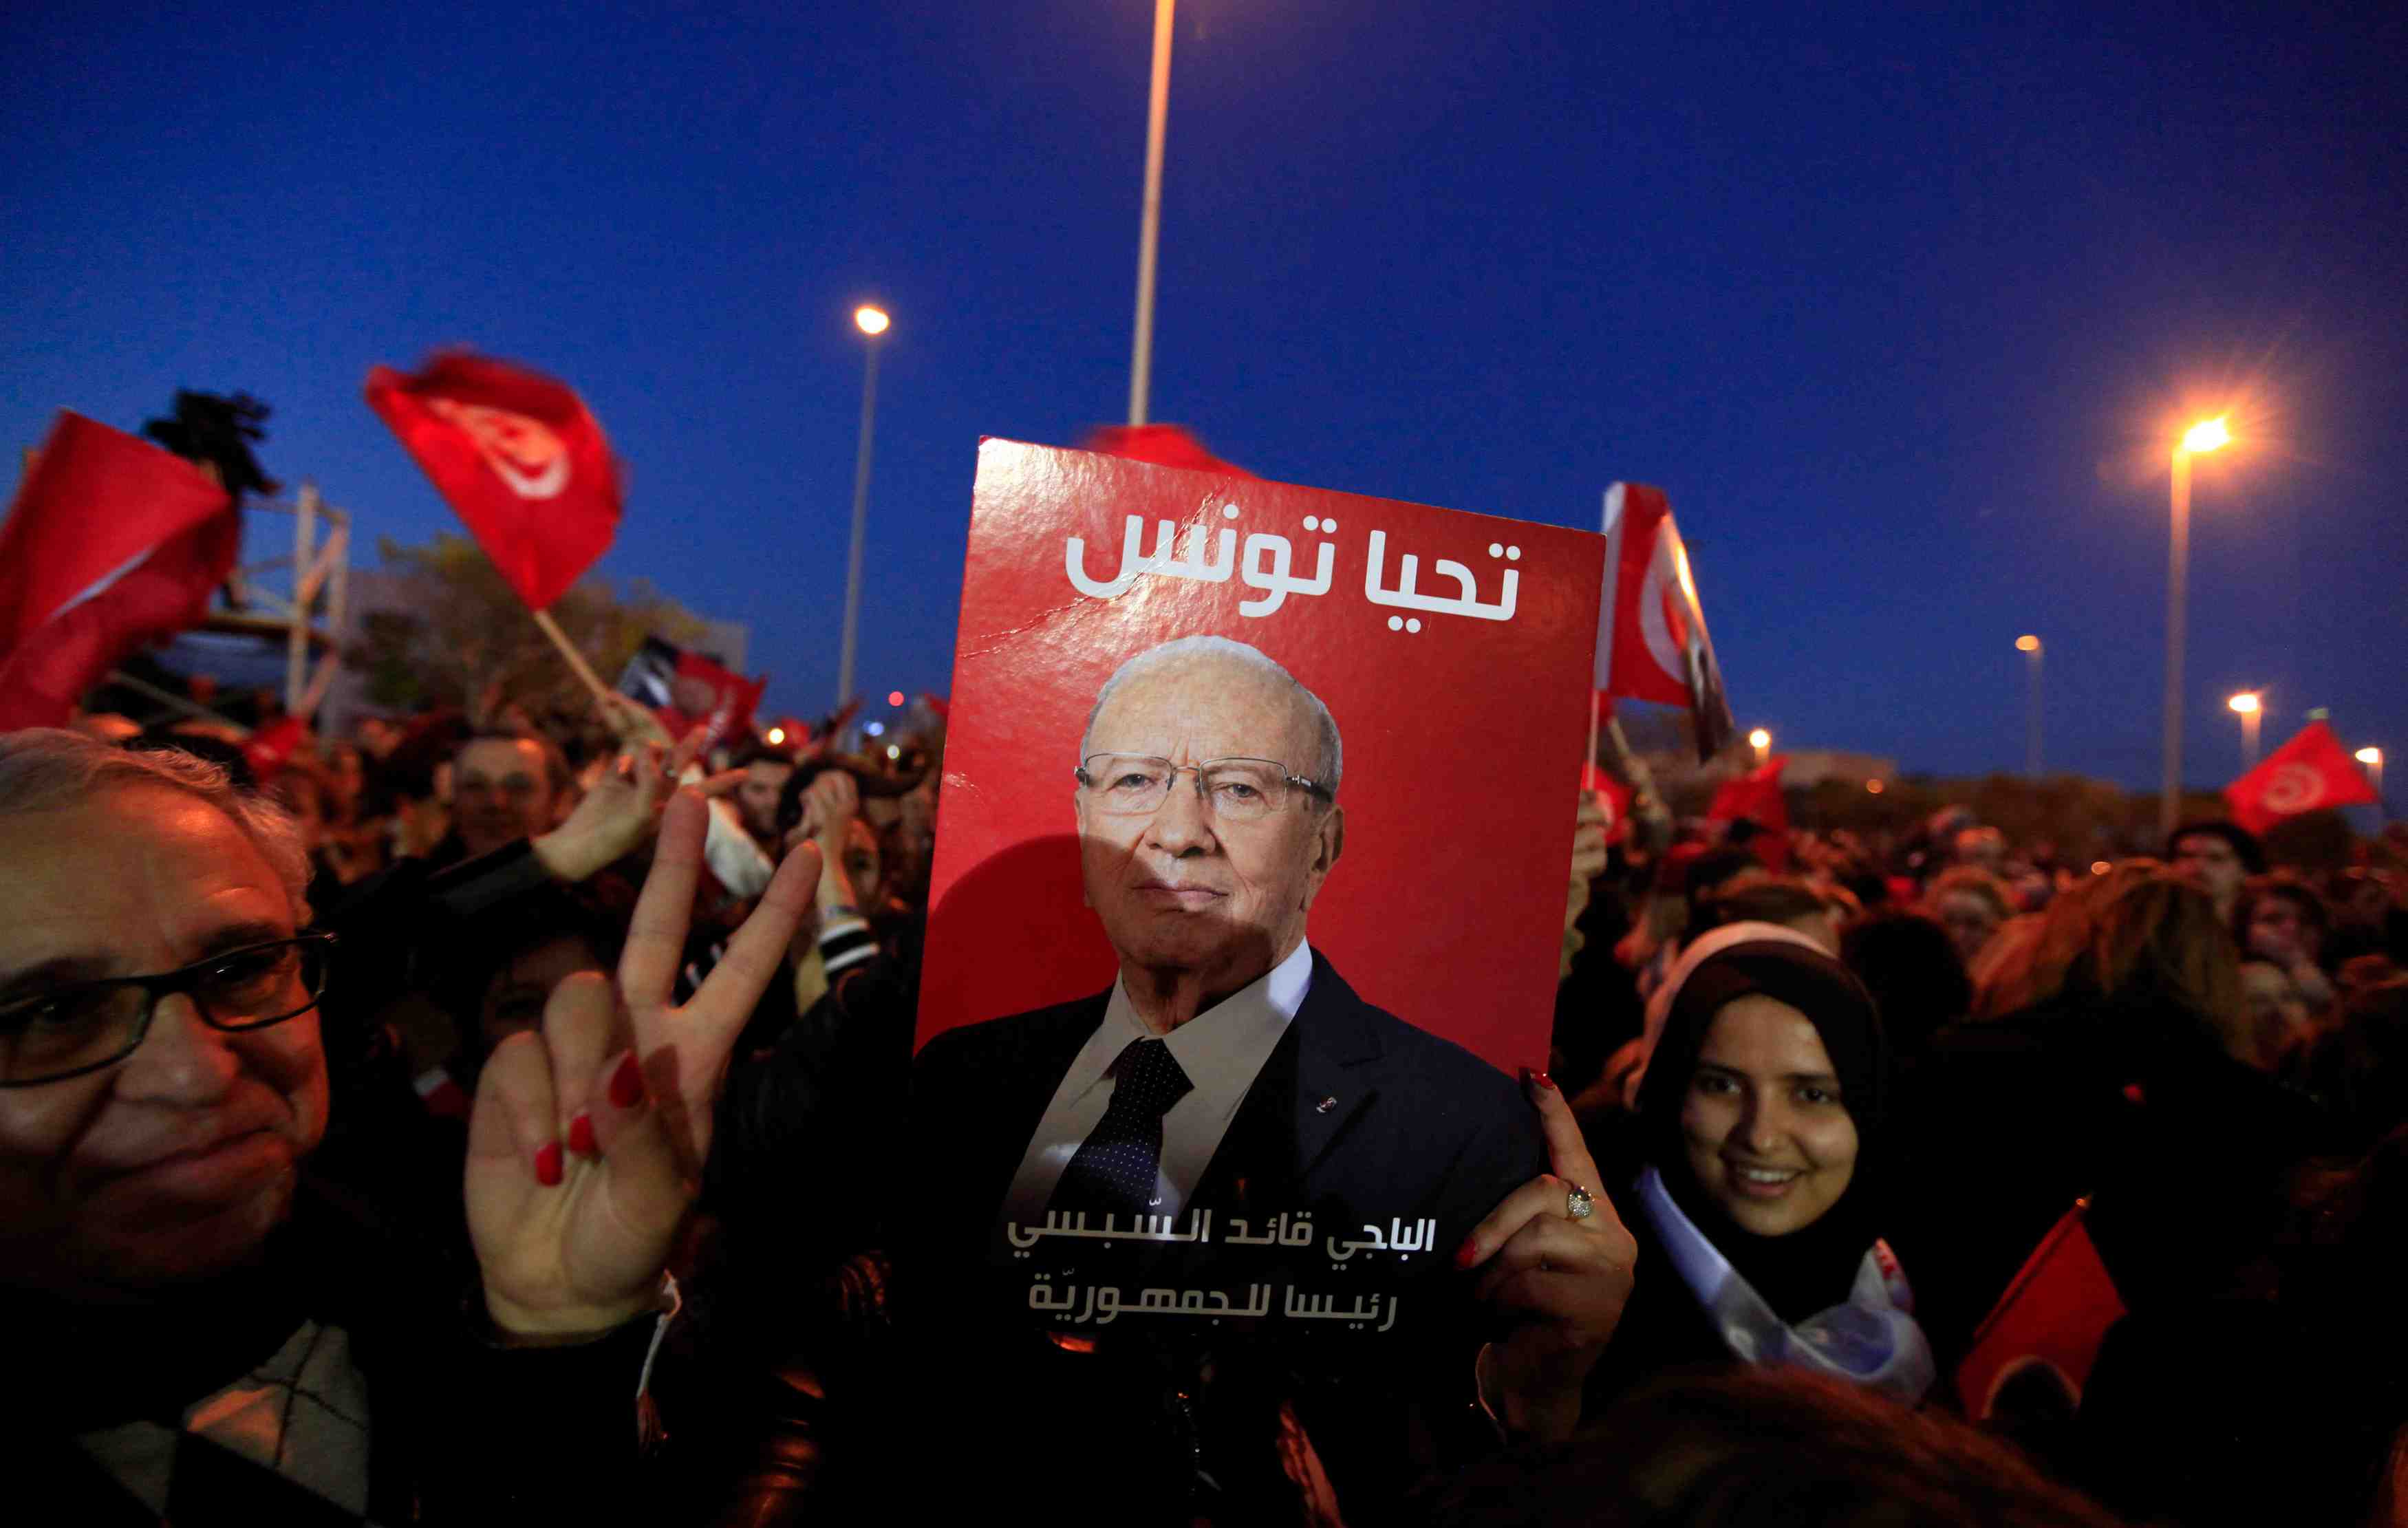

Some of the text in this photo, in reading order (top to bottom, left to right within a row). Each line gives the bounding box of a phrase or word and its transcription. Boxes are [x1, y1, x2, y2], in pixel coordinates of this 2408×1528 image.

[1065, 504, 1520, 634] تحيا تونس
[1225, 1211, 1313, 1245] قائد
[1327, 1217, 1436, 1270] الباجي
[1284, 1284, 1397, 1332] رئيسا
